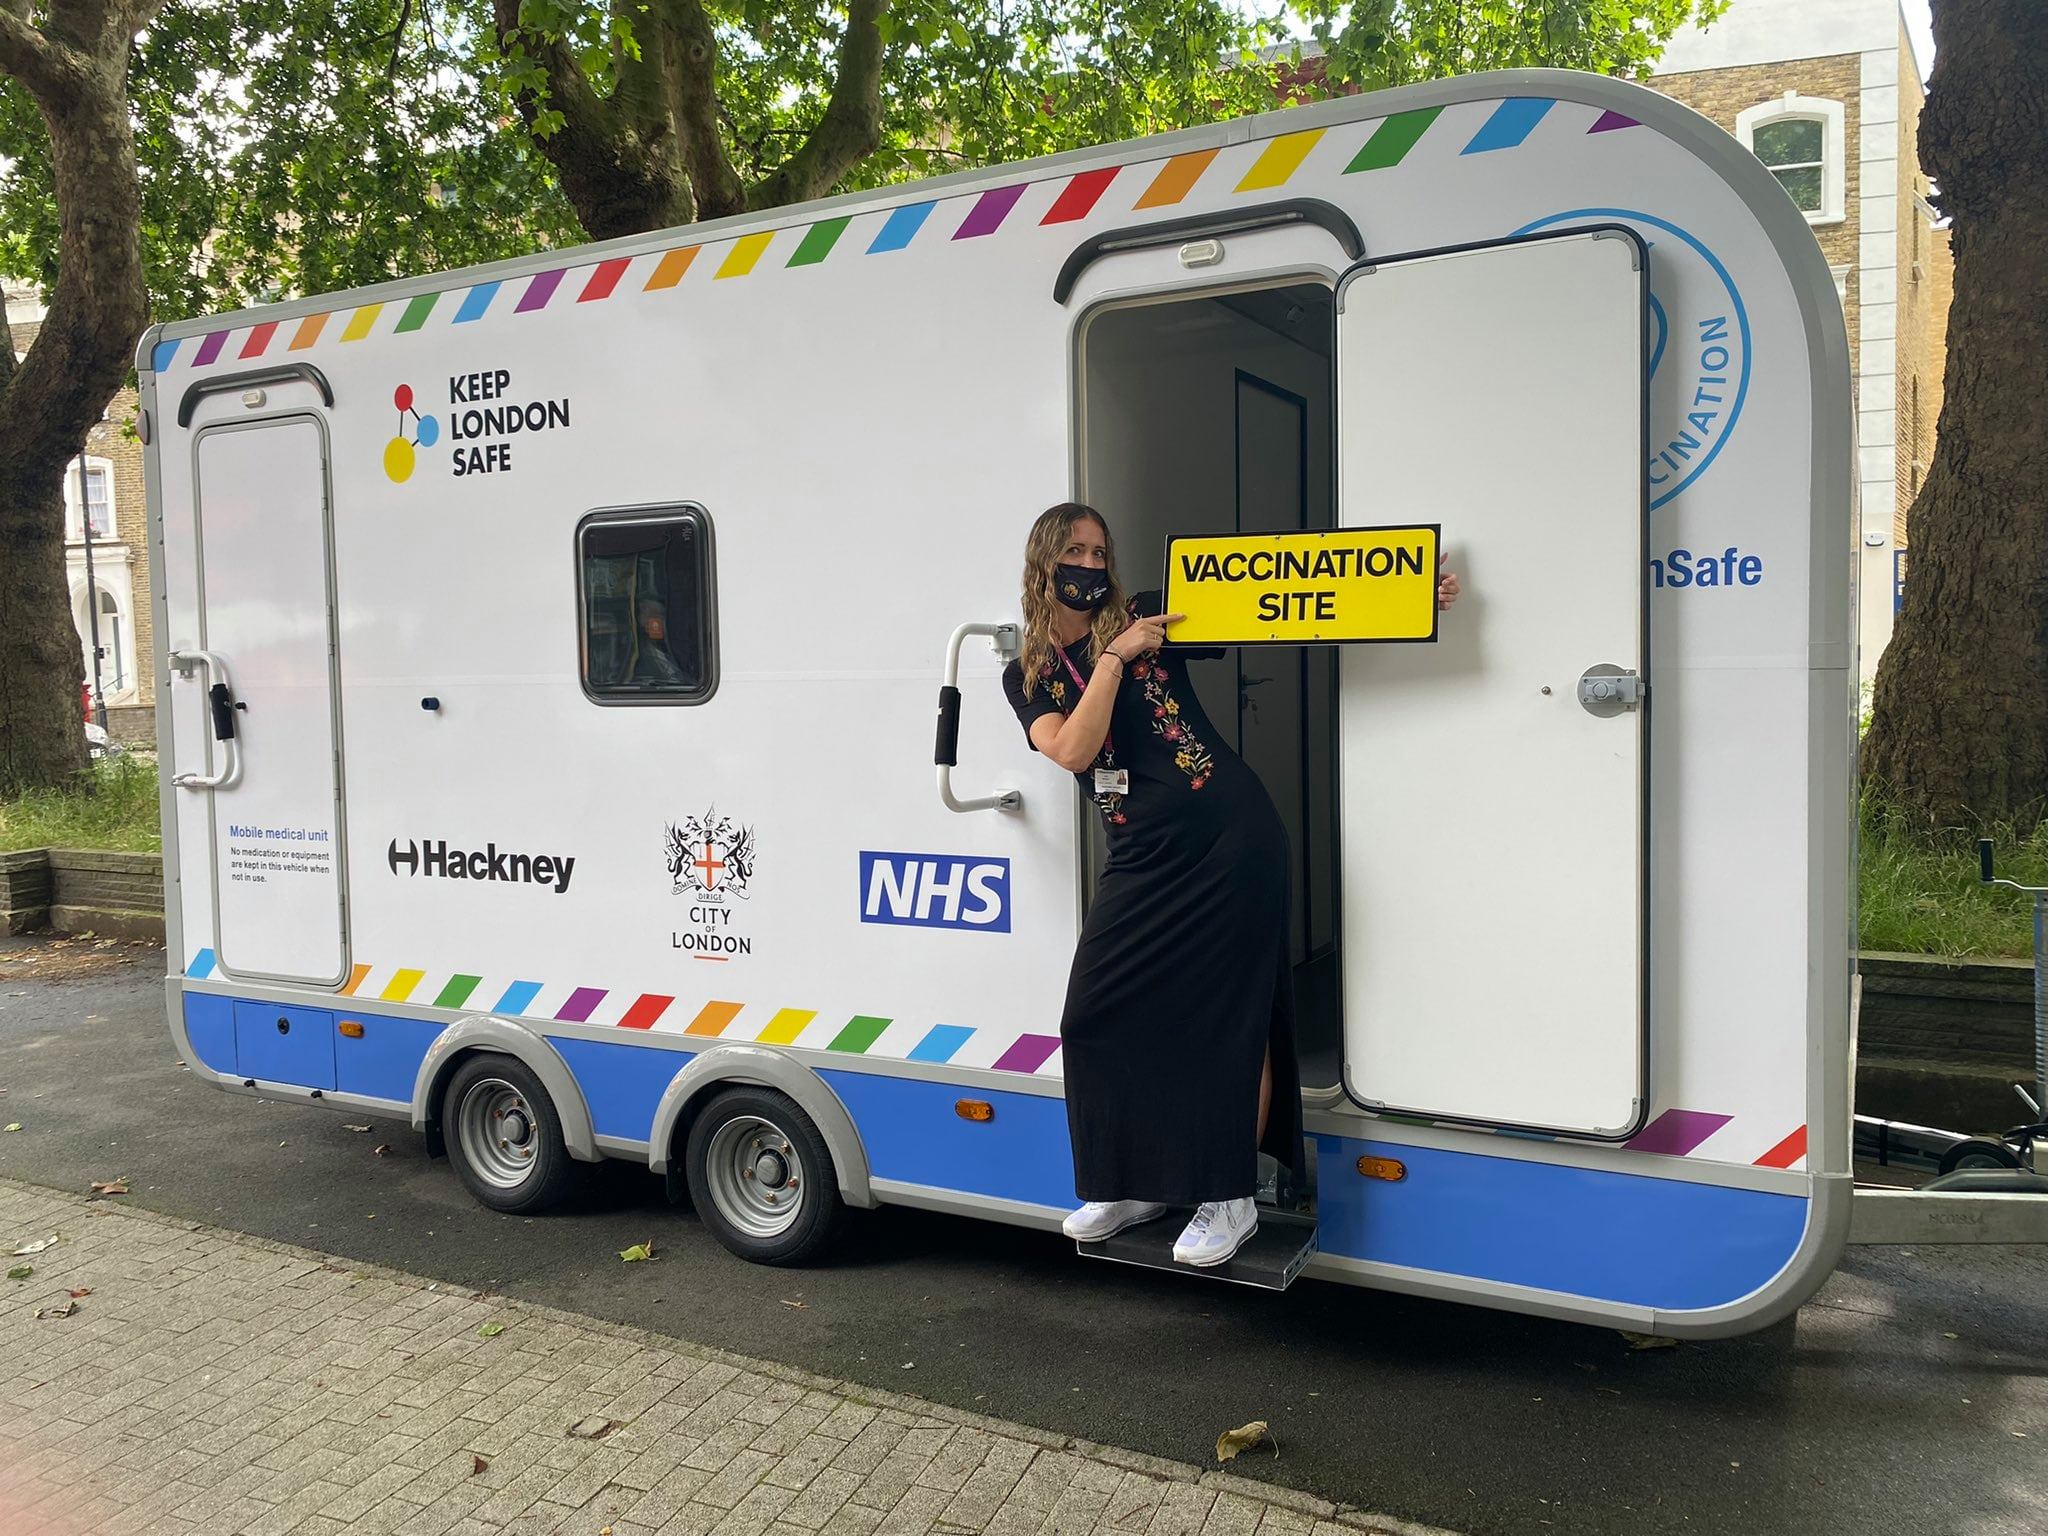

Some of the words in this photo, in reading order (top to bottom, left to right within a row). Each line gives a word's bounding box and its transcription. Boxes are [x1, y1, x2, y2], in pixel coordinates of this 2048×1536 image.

[450, 369, 510, 404] KEEP
[451, 398, 570, 440] LONDON
[452, 443, 511, 477] SAFE
[1181, 546, 1423, 583] VACCINATION
[1257, 591, 1336, 622] SITE
[229, 825, 263, 838] Mobile
[265, 827, 306, 840] medical
[307, 829, 329, 841] unit
[230, 847, 241, 856] No
[241, 847, 280, 858] medication
[281, 850, 290, 858] or
[290, 851, 330, 861] equipment
[231, 860, 242, 868] are
[243, 860, 260, 870] kept
[260, 861, 268, 870] in
[268, 862, 282, 871] this
[283, 864, 309, 873] vehicle
[309, 865, 330, 874] when
[422, 839, 576, 894] Hackney
[231, 873, 243, 881] not
[244, 873, 252, 882] in
[252, 874, 267, 883] use.
[698, 893, 722, 901] DIRIGE
[865, 859, 1006, 925] NHS
[689, 906, 732, 925] CITY
[705, 925, 716, 933] OF
[672, 932, 751, 954] LONDON
